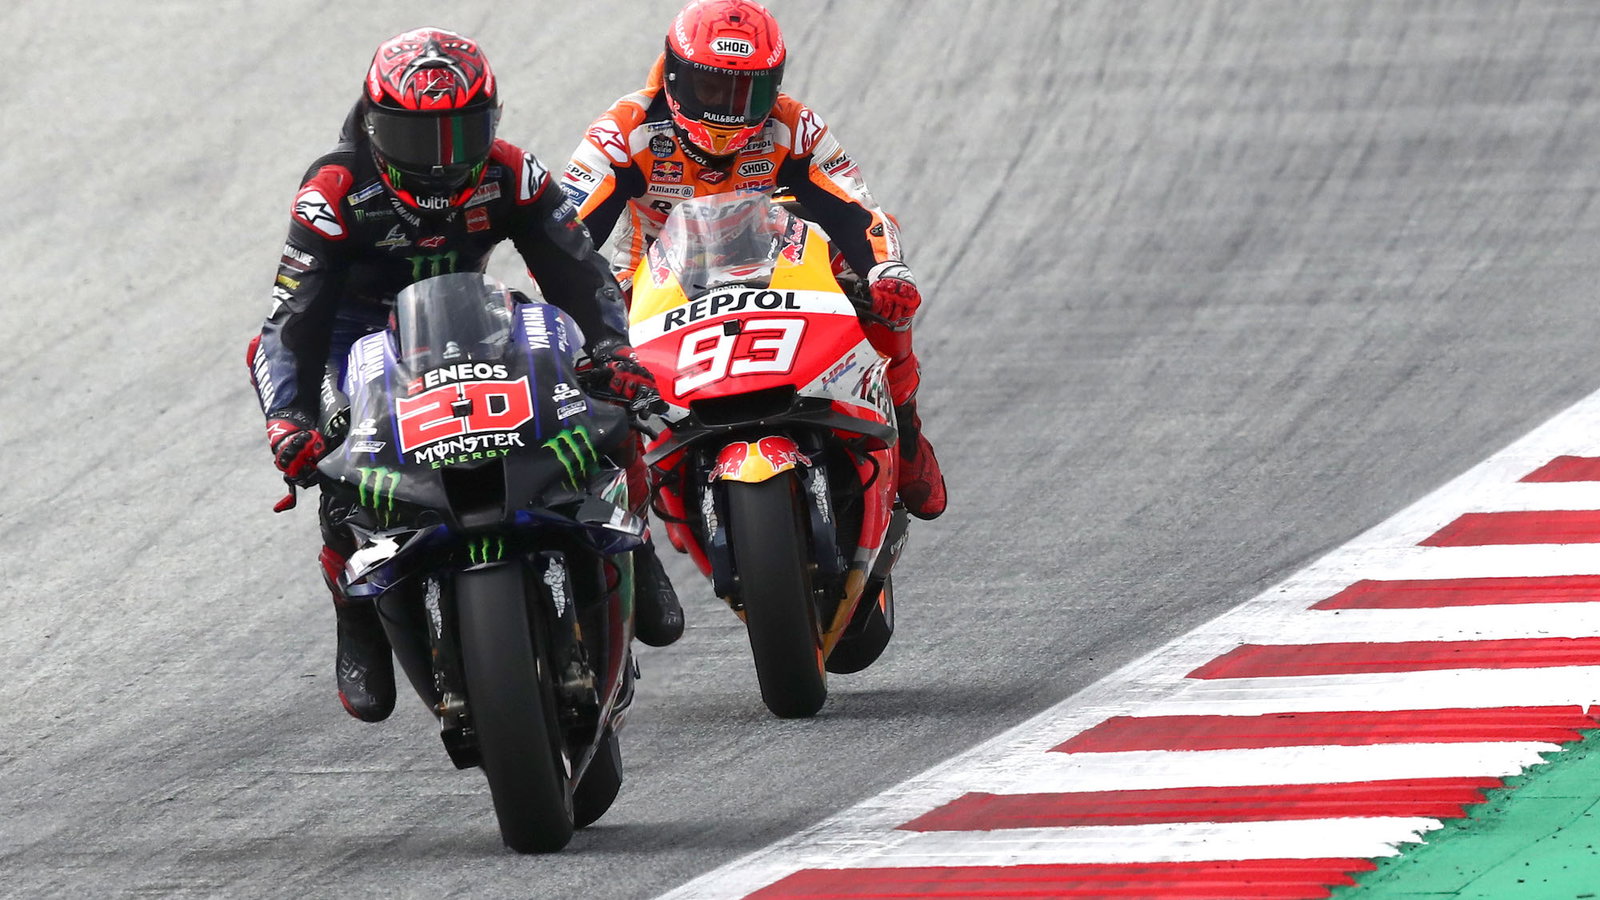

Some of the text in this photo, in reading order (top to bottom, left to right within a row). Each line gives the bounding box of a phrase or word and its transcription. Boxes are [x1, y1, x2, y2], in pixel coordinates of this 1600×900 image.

[717, 41, 749, 54] SHOEI
[694, 63, 718, 73] GIVES
[722, 67, 740, 76] YOU
[704, 111, 745, 124] PULL&BEAR
[742, 162, 770, 175] SHOEI
[649, 185, 680, 195] Allianz
[664, 291, 801, 332] REPSOL
[521, 306, 551, 350] YAMAHA
[675, 318, 807, 398] 93
[424, 363, 509, 389] ENEOS
[414, 432, 526, 465] MONSTER
[431, 448, 510, 470] ENERGY
